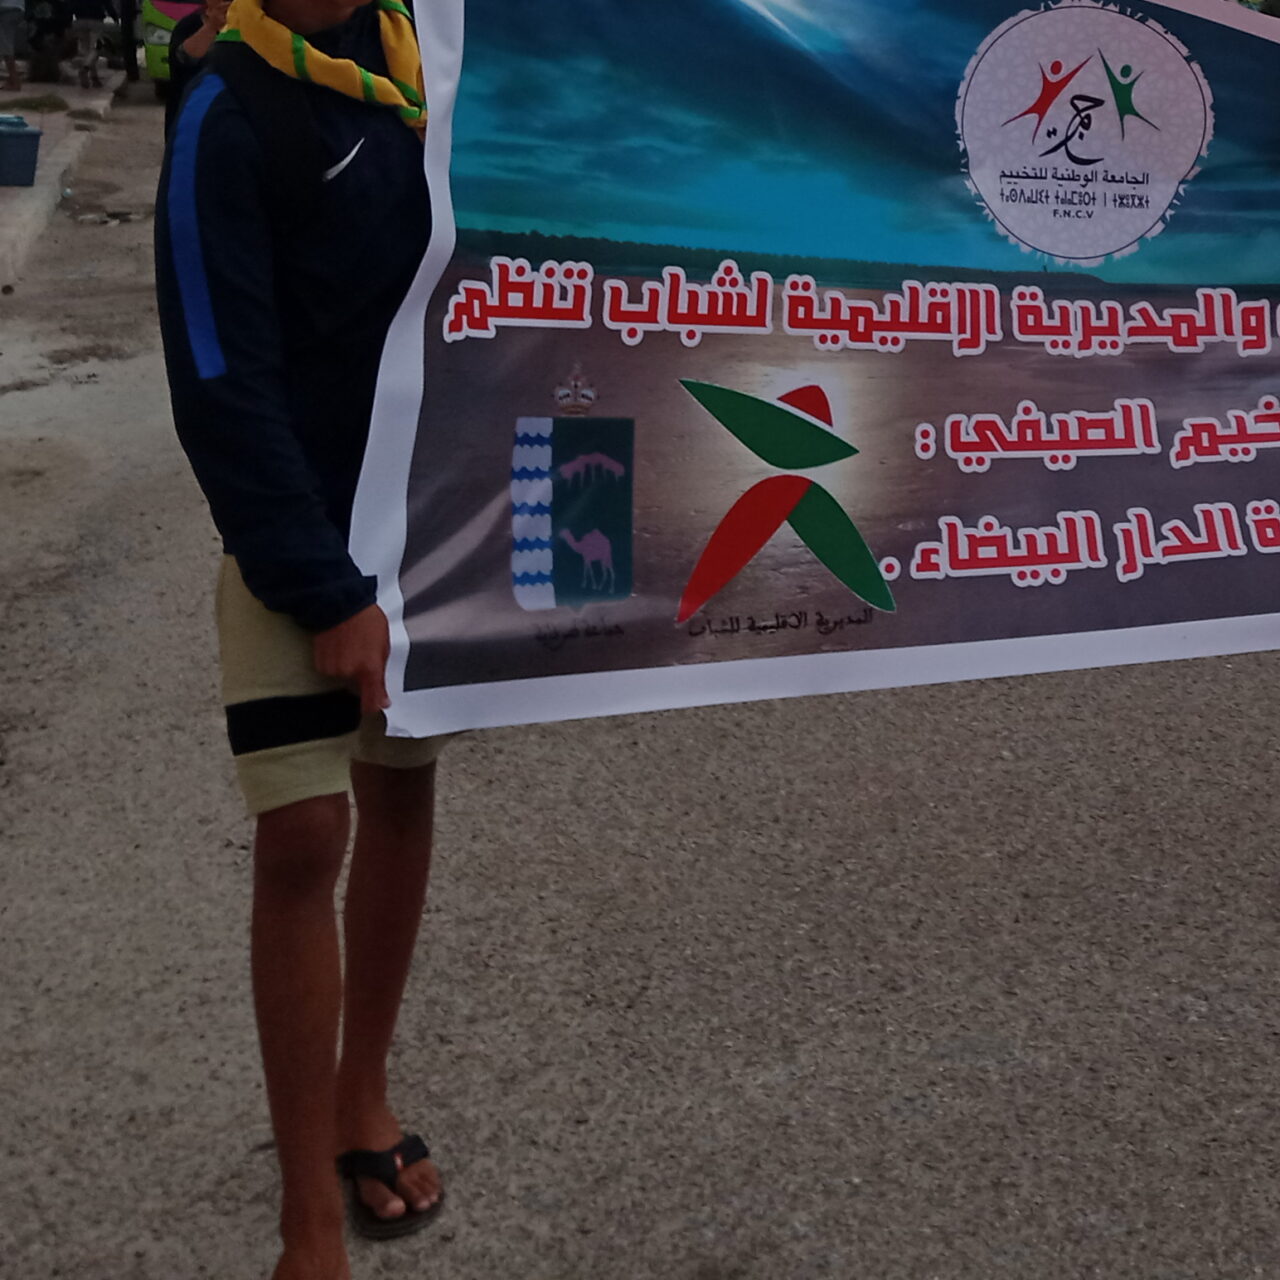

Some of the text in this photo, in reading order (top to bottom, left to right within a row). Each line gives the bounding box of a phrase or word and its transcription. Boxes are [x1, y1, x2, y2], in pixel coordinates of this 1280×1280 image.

[999, 166, 1150, 190] الجامعة الوطنية للتخييم
[443, 255, 595, 343] تنظم
[603, 259, 773, 347] لشباب
[783, 274, 1003, 356] الاقليمية
[1011, 285, 1270, 355] والمديرية
[946, 397, 1161, 472] الصيفي
[1112, 502, 1248, 582] الدار
[815, 608, 873, 635] المديرية
